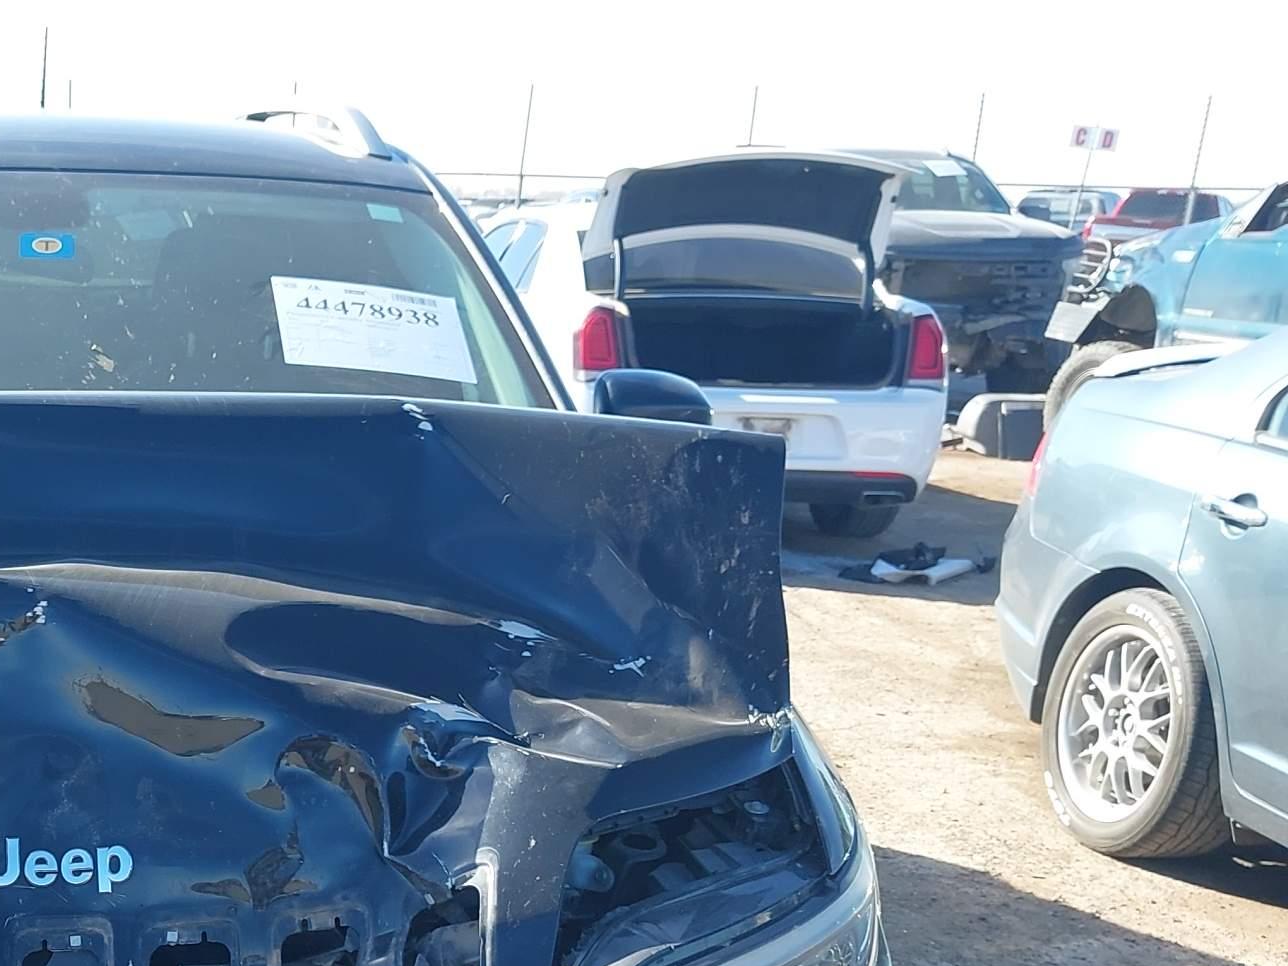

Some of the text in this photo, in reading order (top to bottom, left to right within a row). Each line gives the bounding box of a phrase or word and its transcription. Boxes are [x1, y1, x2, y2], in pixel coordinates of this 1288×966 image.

[1075, 127, 1087, 146] C
[1102, 130, 1114, 149] D
[296, 296, 440, 328] 44478938
